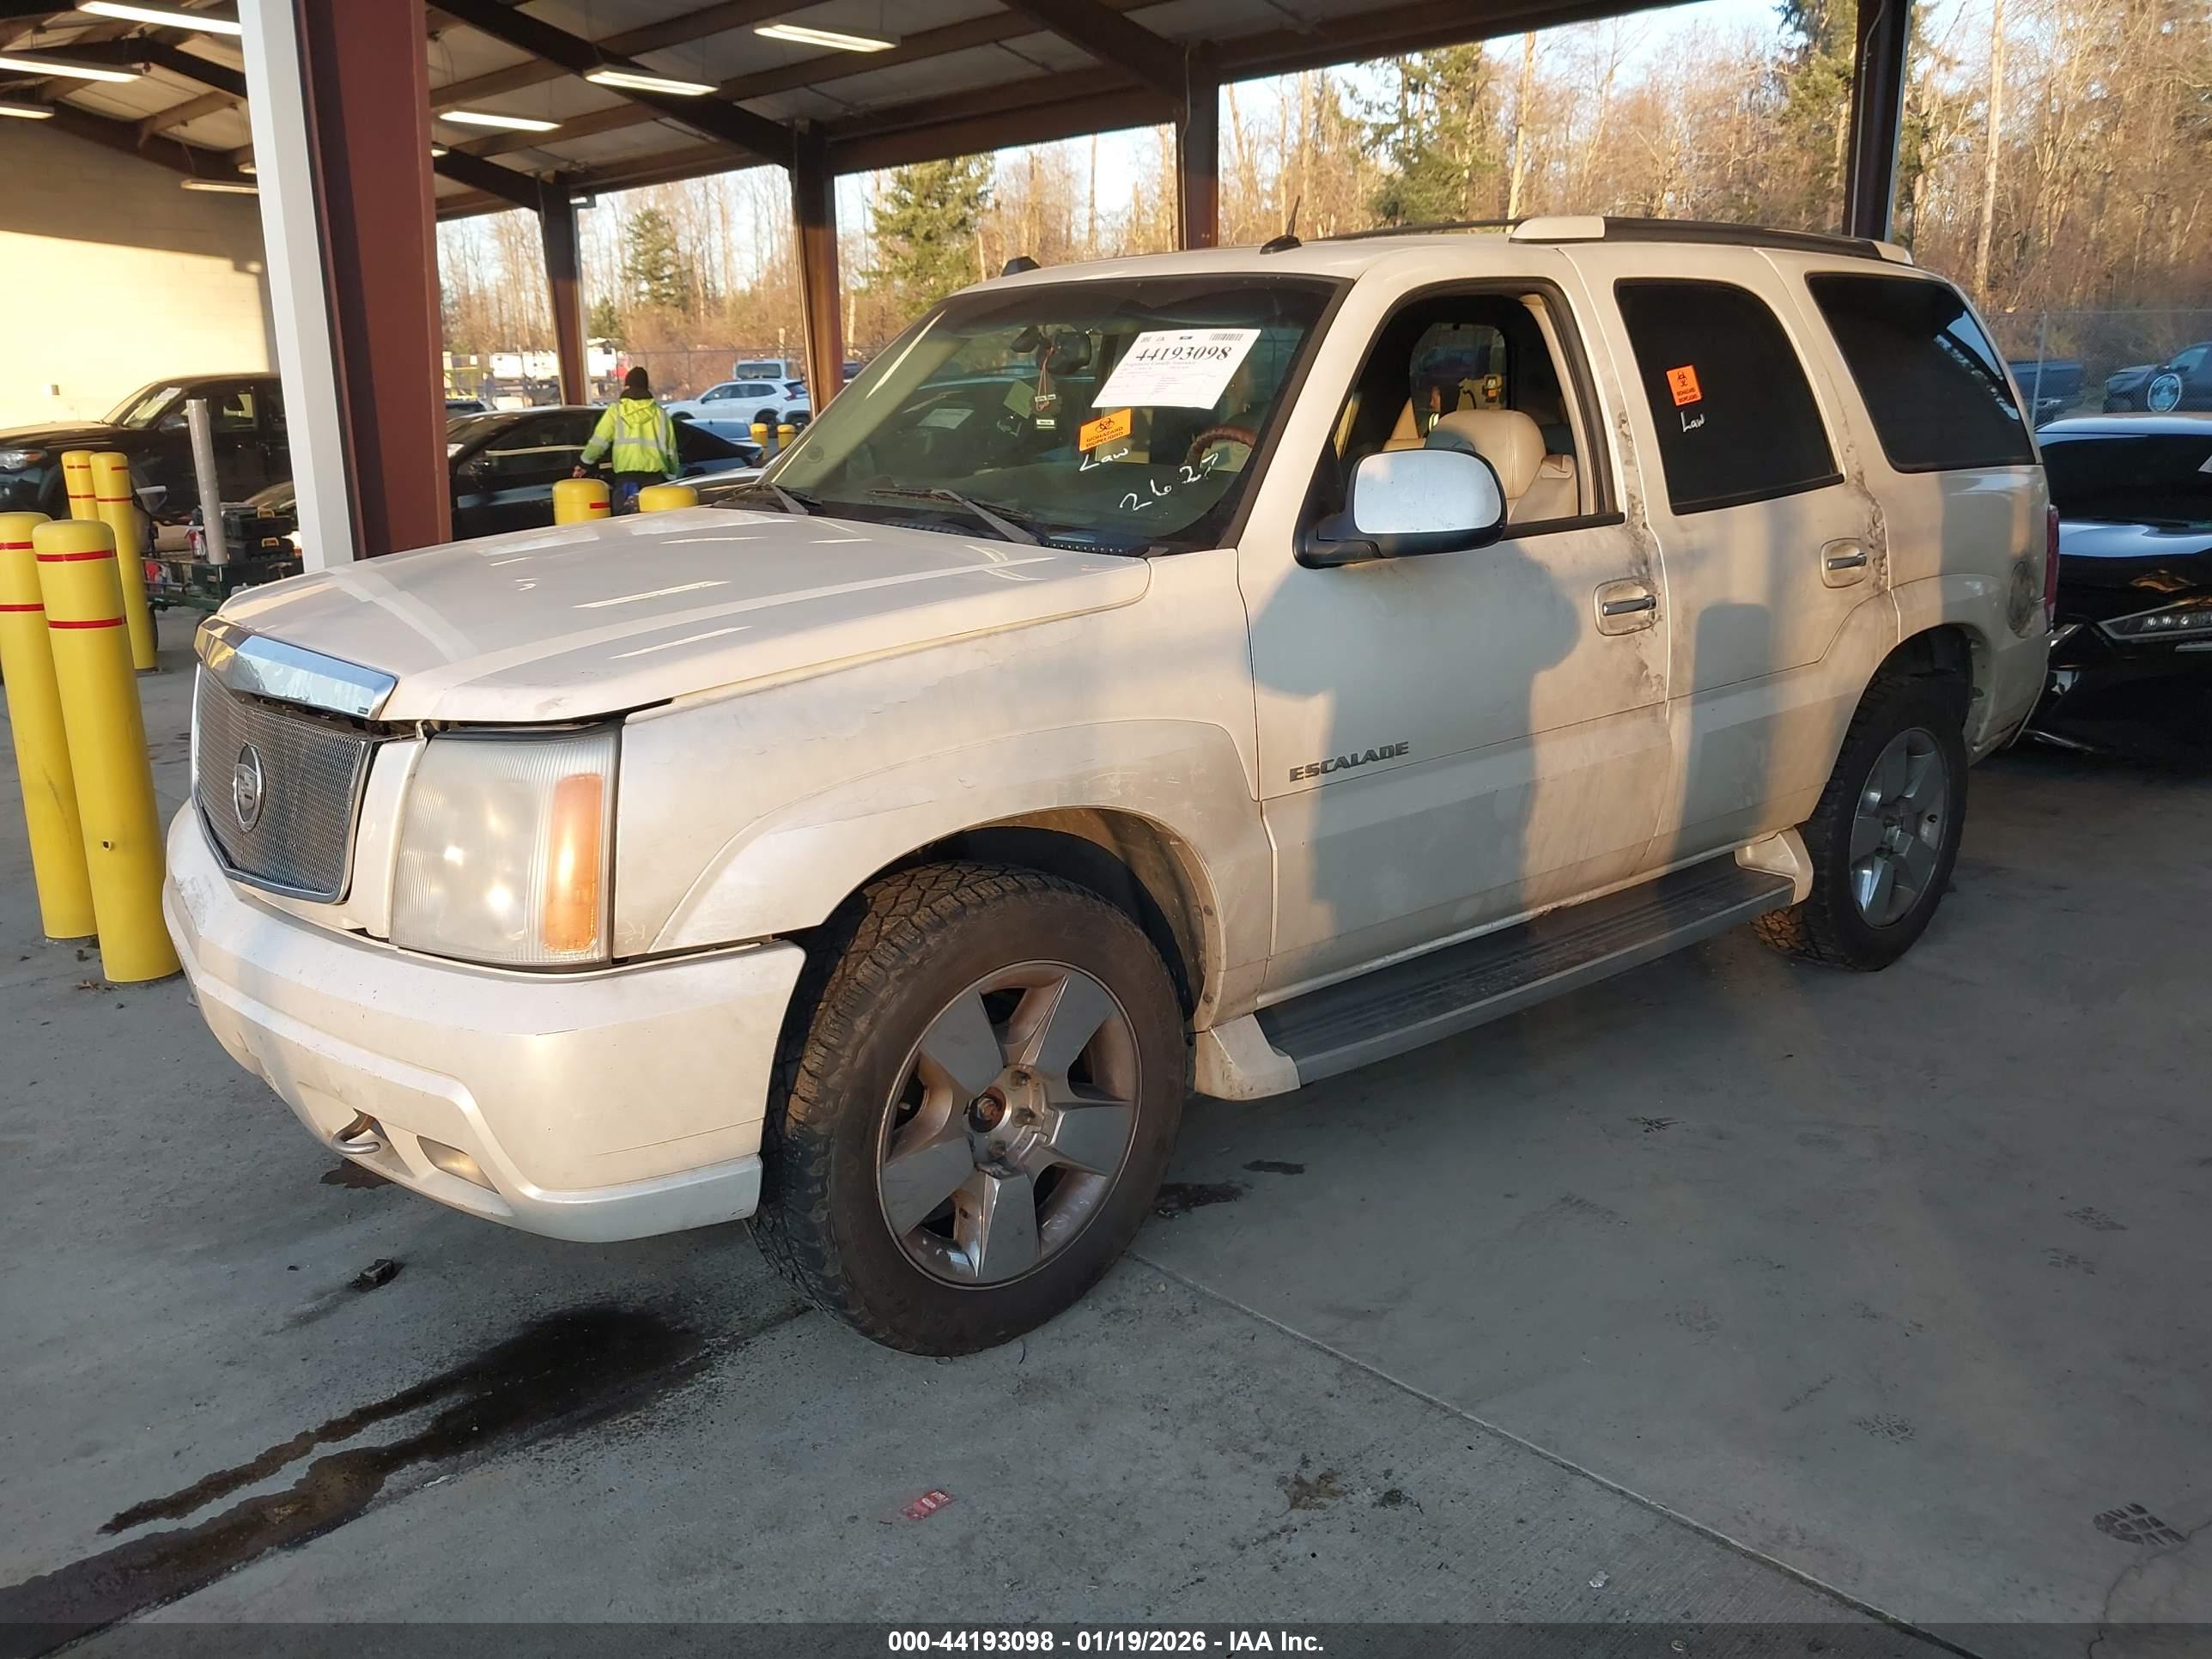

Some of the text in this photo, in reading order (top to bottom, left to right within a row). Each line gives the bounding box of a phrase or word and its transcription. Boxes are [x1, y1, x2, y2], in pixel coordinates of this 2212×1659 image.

[1135, 346, 1232, 362] 44193098
[1680, 411, 1705, 433] Law
[1079, 447, 1129, 471] Law
[1289, 741, 1409, 782] ESCALADE
